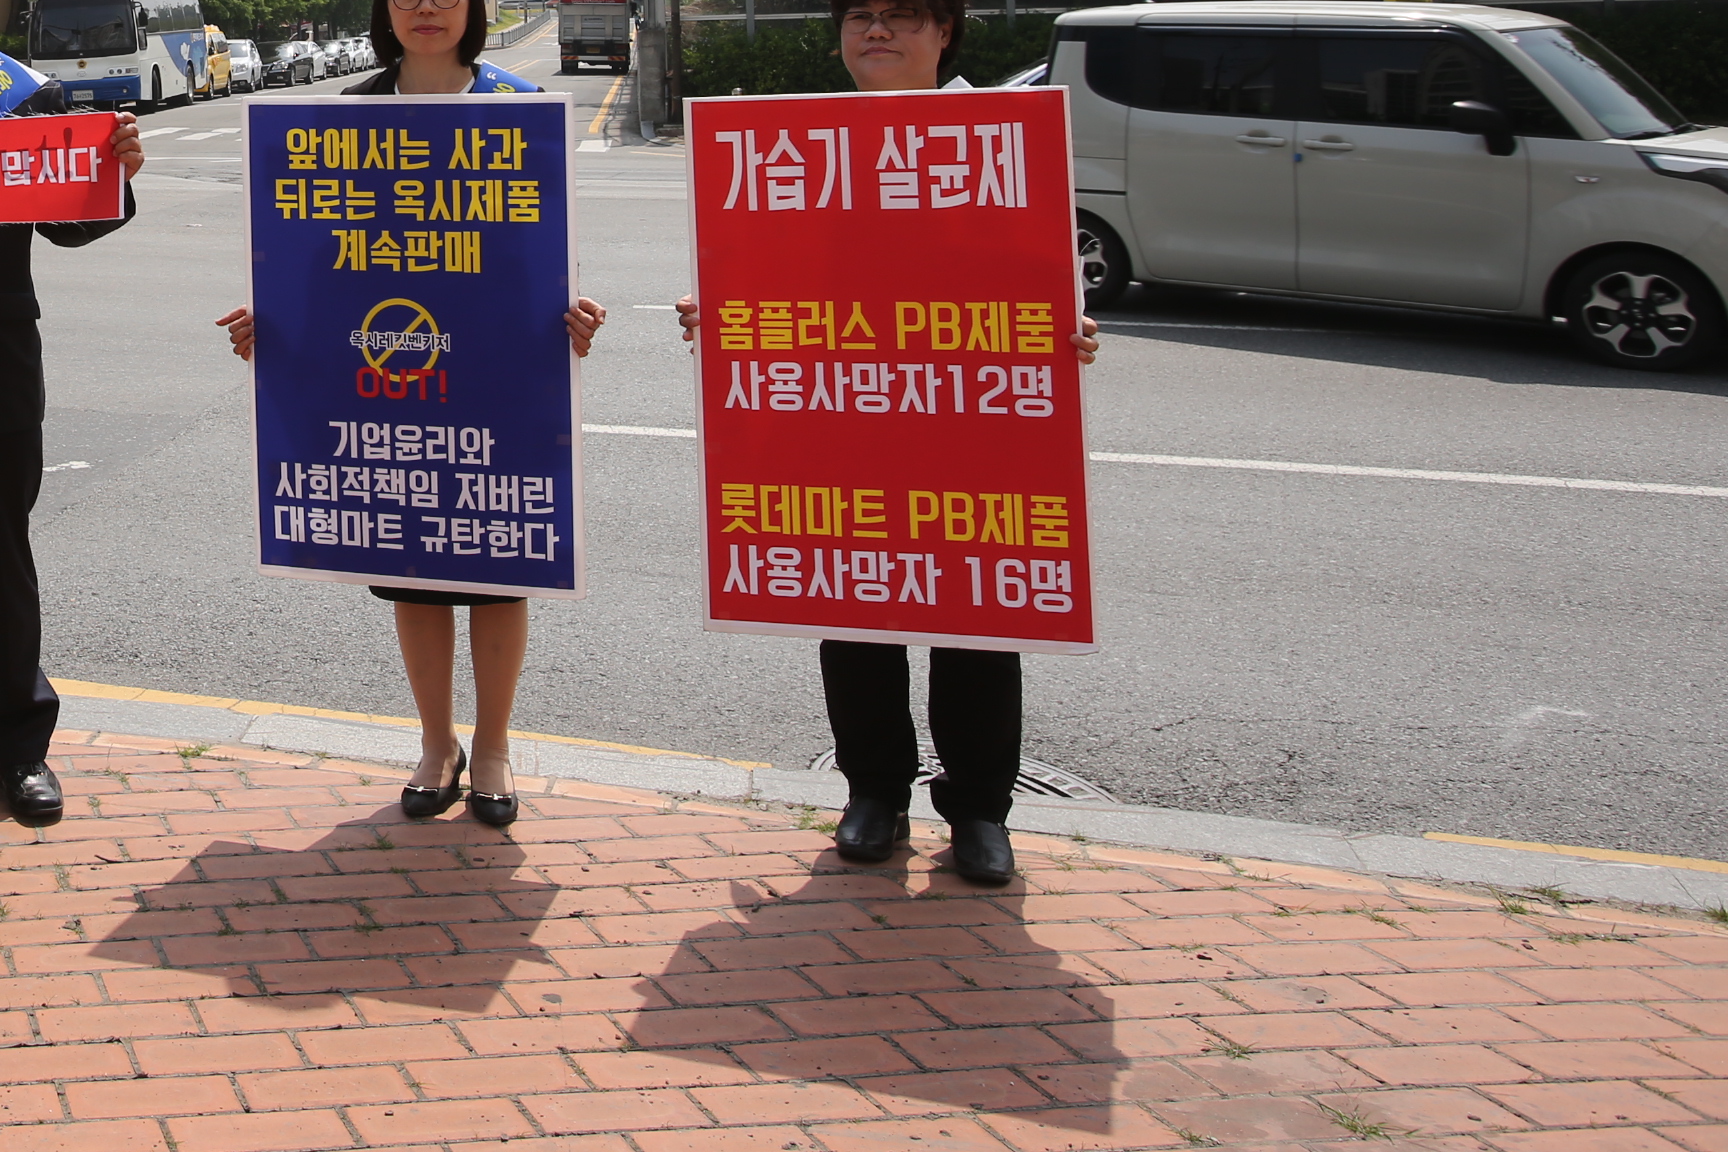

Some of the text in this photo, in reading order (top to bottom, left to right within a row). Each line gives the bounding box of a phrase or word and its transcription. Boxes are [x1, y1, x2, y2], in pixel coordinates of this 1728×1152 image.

[285, 128, 528, 170] 앞에서는 사과
[715, 121, 1028, 211] 가습기 살균제
[275, 178, 541, 223] 뒤로는 옥시제품
[331, 229, 481, 274] 계속판매
[350, 330, 451, 352] 옥시레킷벤키저
[718, 299, 1055, 354] 홈플러스 PB제품
[356, 366, 447, 403] OUT!
[328, 420, 495, 466] 기업윤리와
[275, 461, 554, 514] 사회적책임 저버린
[273, 505, 560, 562] 대형마트 규탄한다
[720, 482, 1070, 548] 롯데마트 PB제품
[722, 544, 1073, 614] 사용사망자 16명
